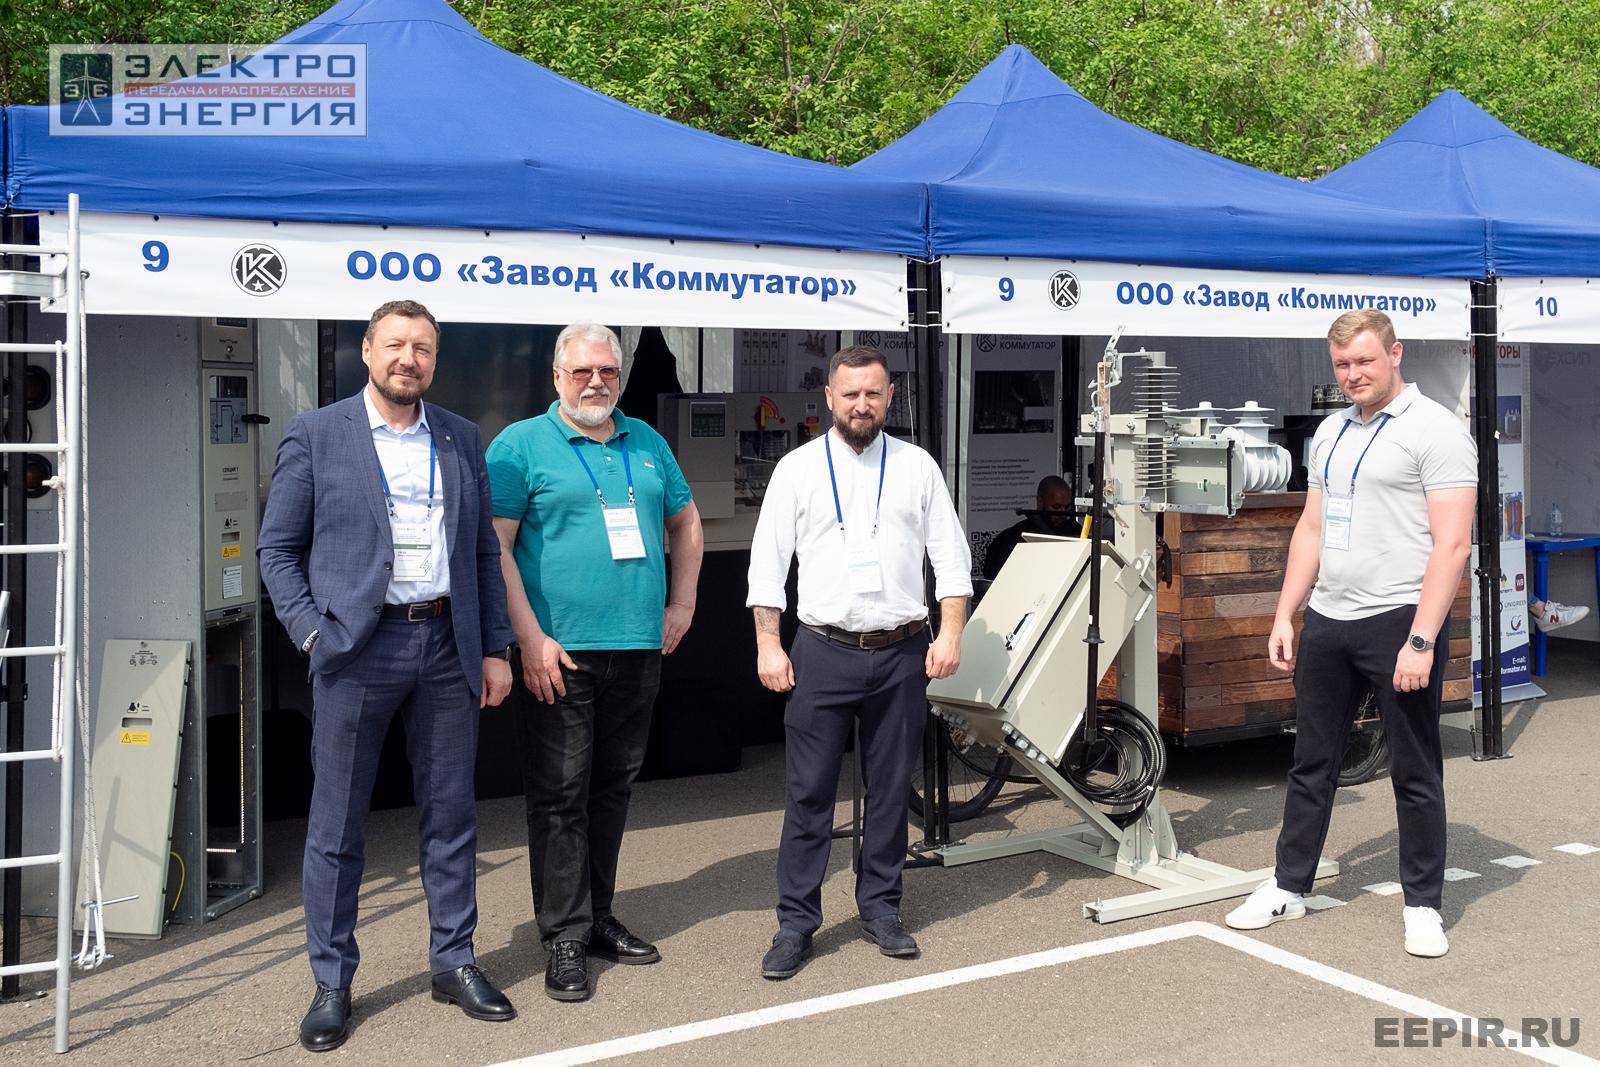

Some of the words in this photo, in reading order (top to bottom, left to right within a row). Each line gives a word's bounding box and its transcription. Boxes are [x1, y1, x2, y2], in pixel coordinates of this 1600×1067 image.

[142, 240, 170, 273] 9
[347, 250, 442, 283] ООО
[458, 255, 597, 293] «Завод
[609, 262, 857, 302] «Коммутатор»
[998, 277, 1015, 301] 9
[1116, 281, 1174, 305] ООО
[1183, 284, 1270, 311] «Завод
[1535, 297, 1558, 316] 10
[999, 341, 1056, 350] КОММУТАТОР
